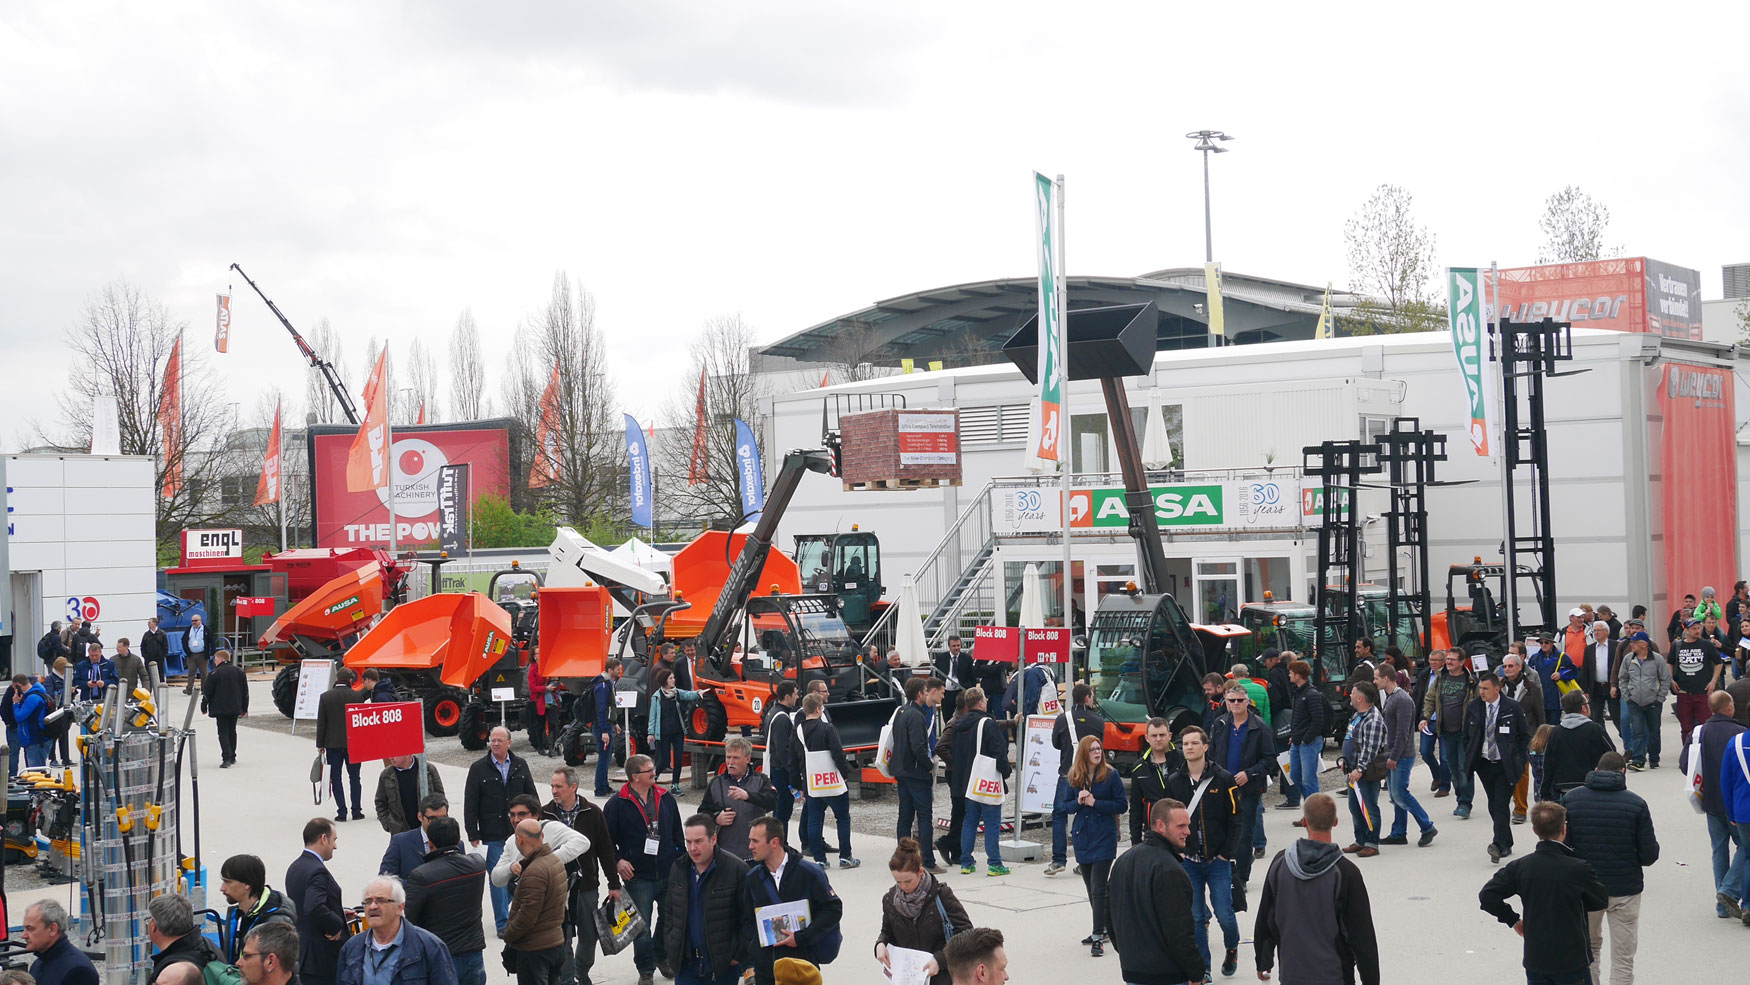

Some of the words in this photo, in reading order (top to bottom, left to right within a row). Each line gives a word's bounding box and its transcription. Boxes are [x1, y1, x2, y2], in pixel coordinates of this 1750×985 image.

[1500, 295, 1627, 323] weycor
[219, 307, 229, 340] ATLAS
[1679, 370, 1724, 408] weycor
[394, 491, 436, 499] ACHINERY
[1096, 493, 1219, 519] ASA
[1247, 505, 1286, 524] years
[1012, 511, 1047, 529] years
[343, 523, 391, 542] THE
[331, 597, 359, 613] AUSA
[484, 630, 494, 653] AUSA
[976, 627, 993, 638] Block
[994, 628, 1007, 639] 808
[1028, 630, 1045, 640] Block
[1046, 631, 1059, 640] 808
[754, 700, 760, 711] 20
[352, 711, 381, 728] Block
[382, 708, 402, 724] 808
[815, 772, 839, 786] PERI
